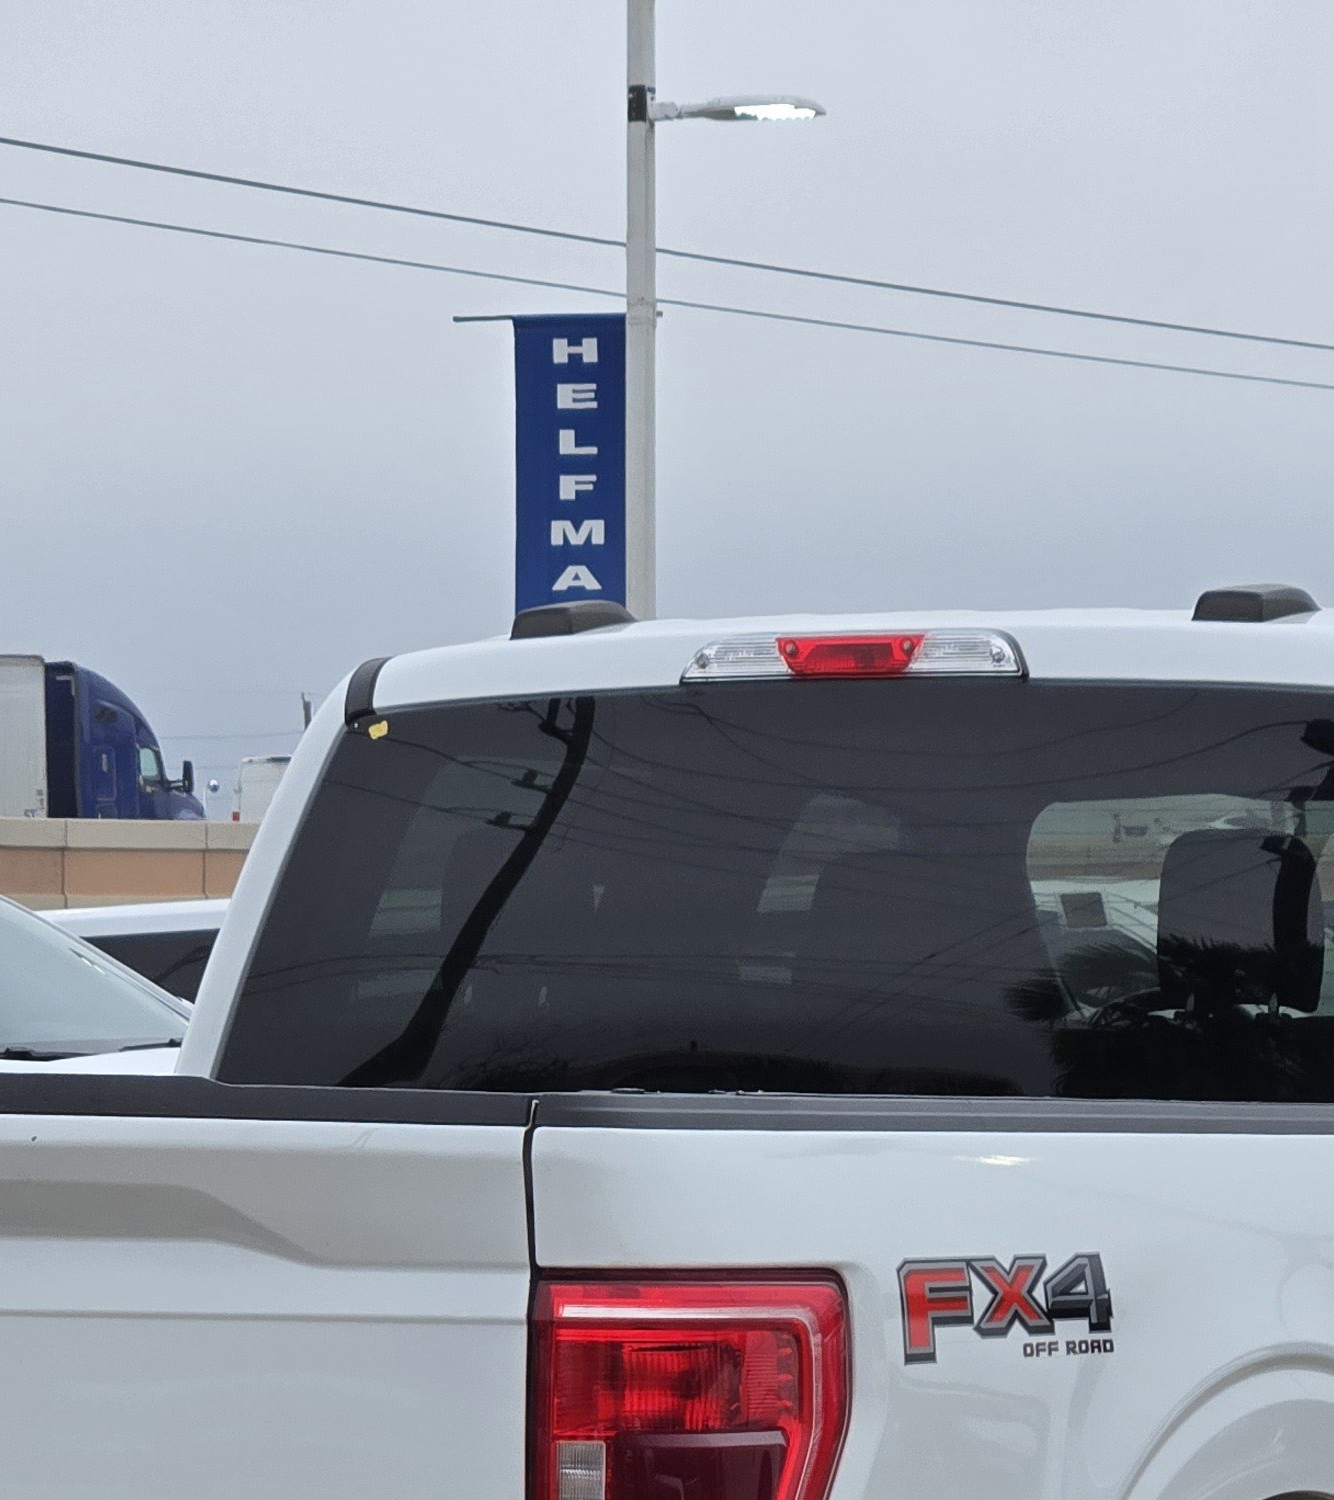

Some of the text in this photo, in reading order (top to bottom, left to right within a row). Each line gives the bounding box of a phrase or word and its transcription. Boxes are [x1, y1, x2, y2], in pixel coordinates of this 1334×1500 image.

[551, 337, 605, 591] HELFMA
[896, 1252, 1114, 1366] FX4
[1023, 1338, 1115, 1357] OFF ROAD
